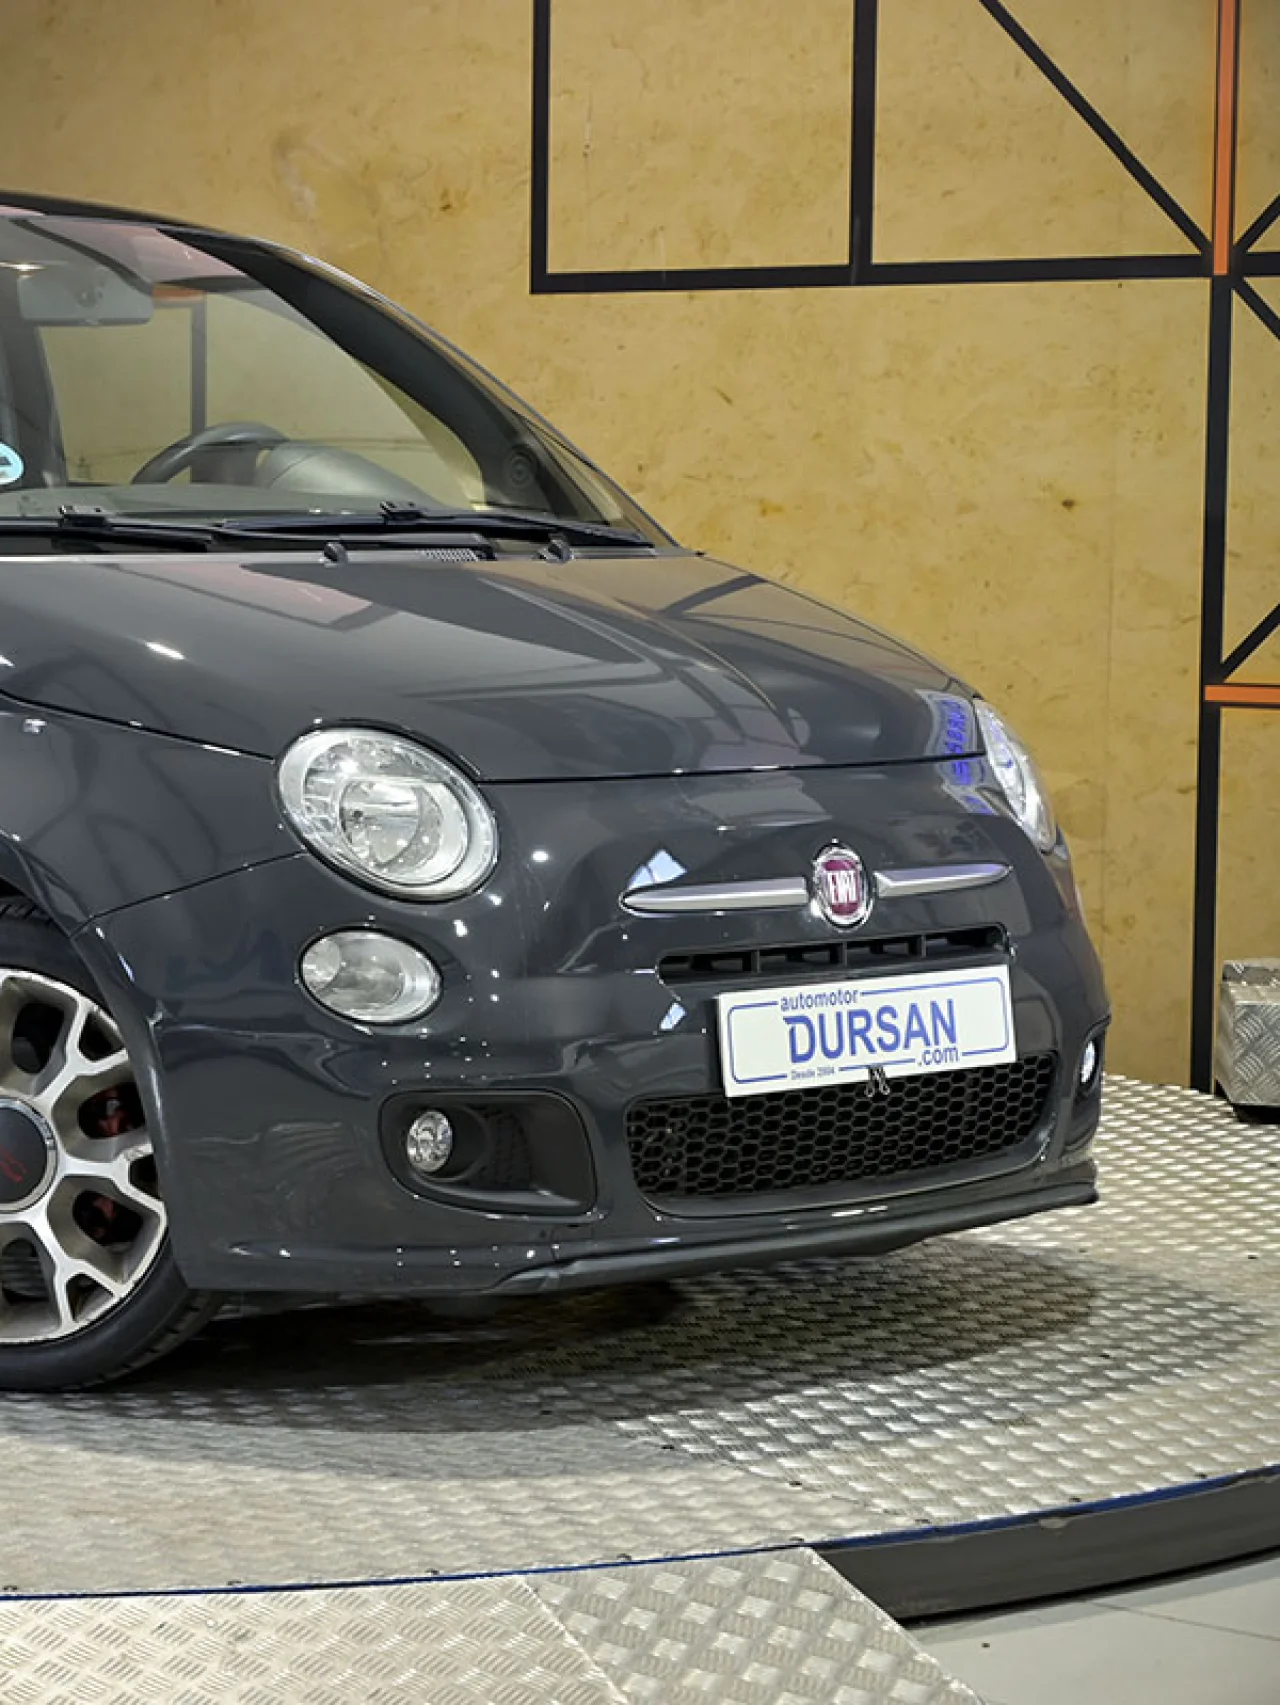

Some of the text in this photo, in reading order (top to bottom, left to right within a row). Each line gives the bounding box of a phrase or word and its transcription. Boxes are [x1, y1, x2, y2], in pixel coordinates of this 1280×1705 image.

[780, 988, 858, 1012] automotor
[783, 998, 957, 1064] DURSAN
[917, 1046, 960, 1067] .com
